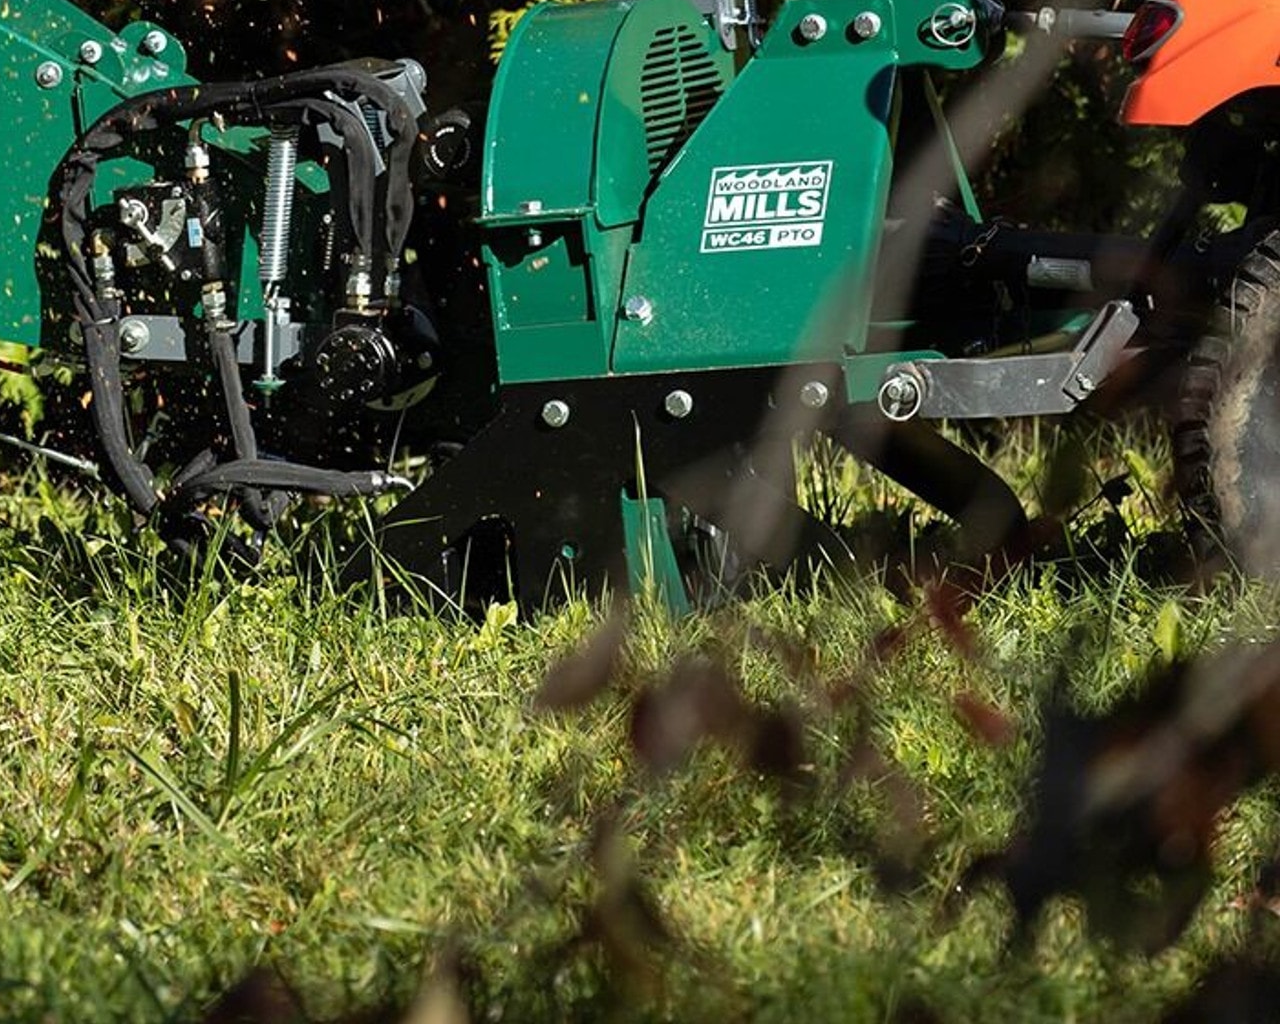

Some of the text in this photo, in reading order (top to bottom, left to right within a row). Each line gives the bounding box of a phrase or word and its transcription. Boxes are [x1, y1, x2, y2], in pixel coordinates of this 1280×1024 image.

[718, 175, 823, 192] WOODLAND
[710, 190, 822, 223] MILLS
[710, 228, 816, 248] WC46 PTO
